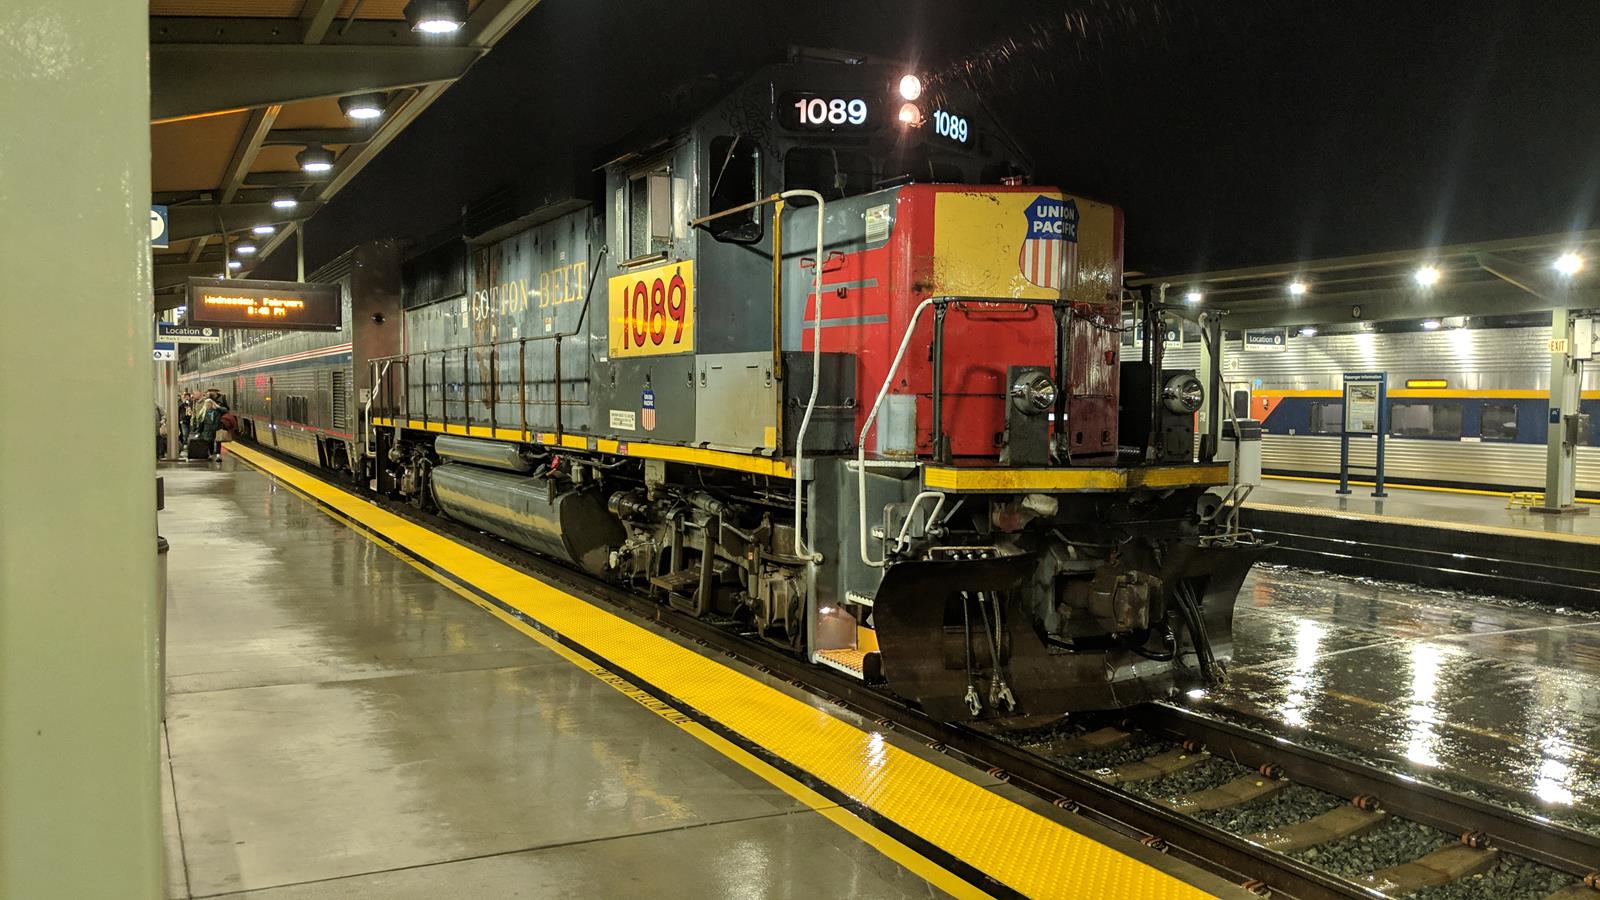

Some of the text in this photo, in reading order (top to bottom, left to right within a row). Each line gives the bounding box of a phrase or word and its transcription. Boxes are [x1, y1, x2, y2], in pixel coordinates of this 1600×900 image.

[794, 98, 867, 125] 1089
[933, 110, 968, 143] 1089
[1037, 205, 1075, 220] UNION
[1033, 220, 1076, 237] PACIFIC
[472, 278, 528, 321] COTTON
[539, 261, 587, 308] BELT
[624, 274, 686, 350] 1089
[165, 327, 200, 335] Location
[1249, 335, 1273, 344] Location
[1551, 340, 1565, 351] EXIT
